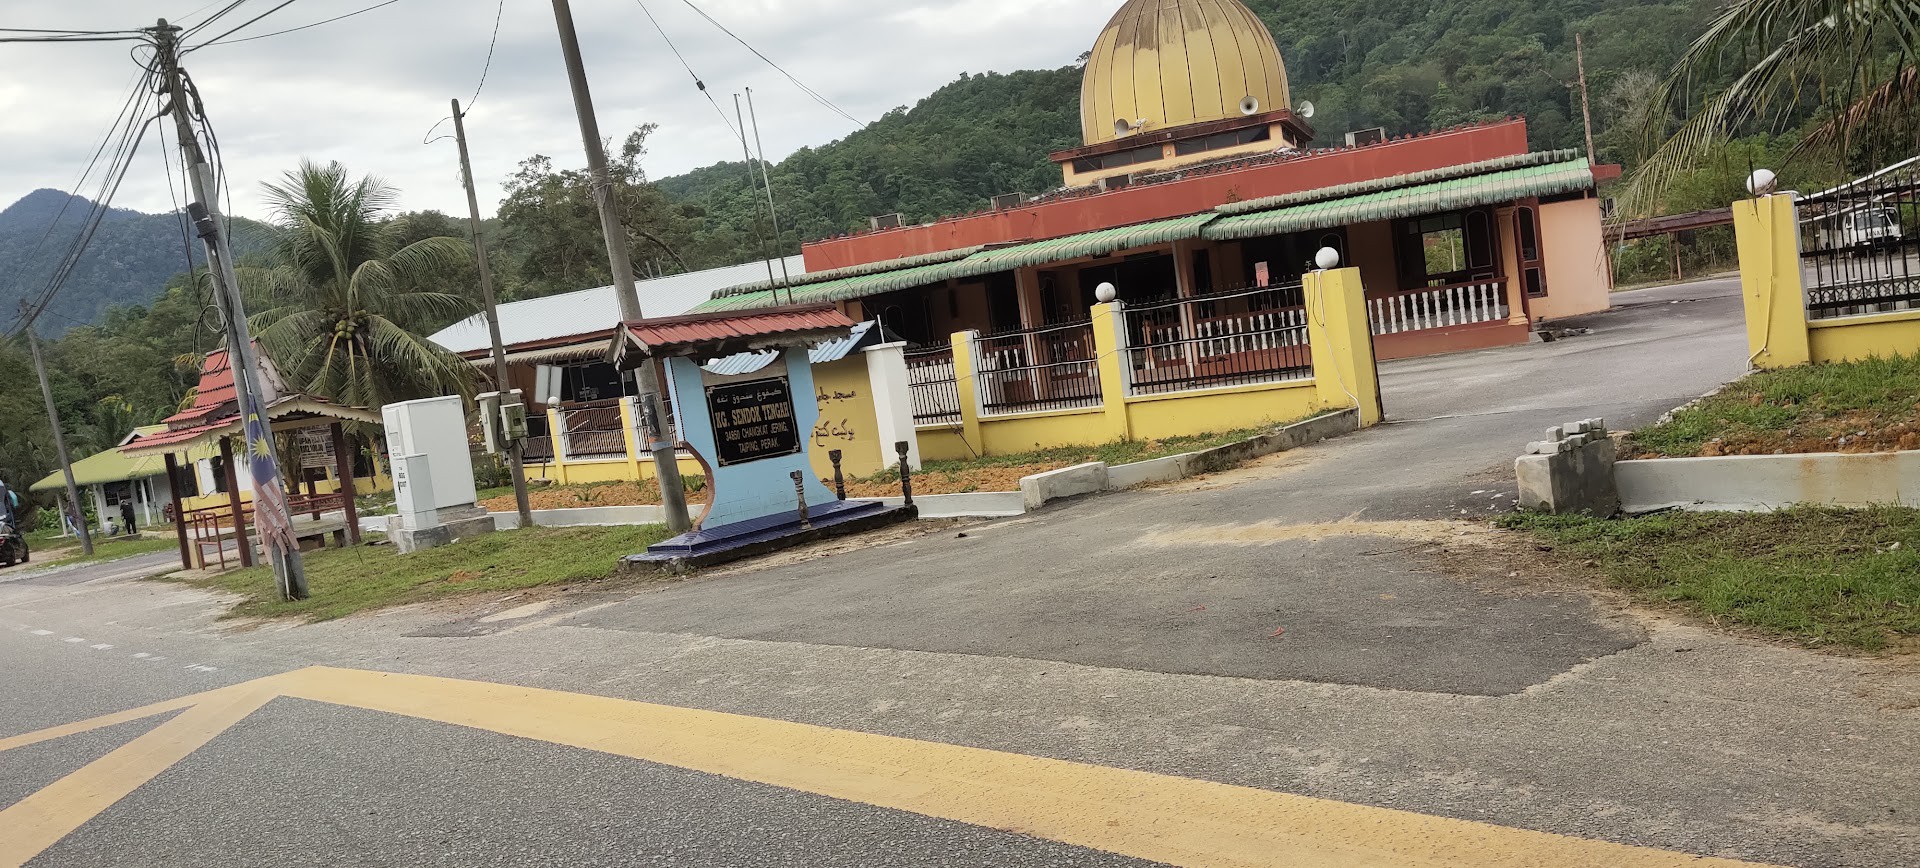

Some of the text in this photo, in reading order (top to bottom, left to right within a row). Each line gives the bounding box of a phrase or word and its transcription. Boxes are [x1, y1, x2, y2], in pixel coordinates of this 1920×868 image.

[715, 401, 790, 428] KG. SENDOK TENGAH
[741, 424, 769, 439] CHANGKAT
